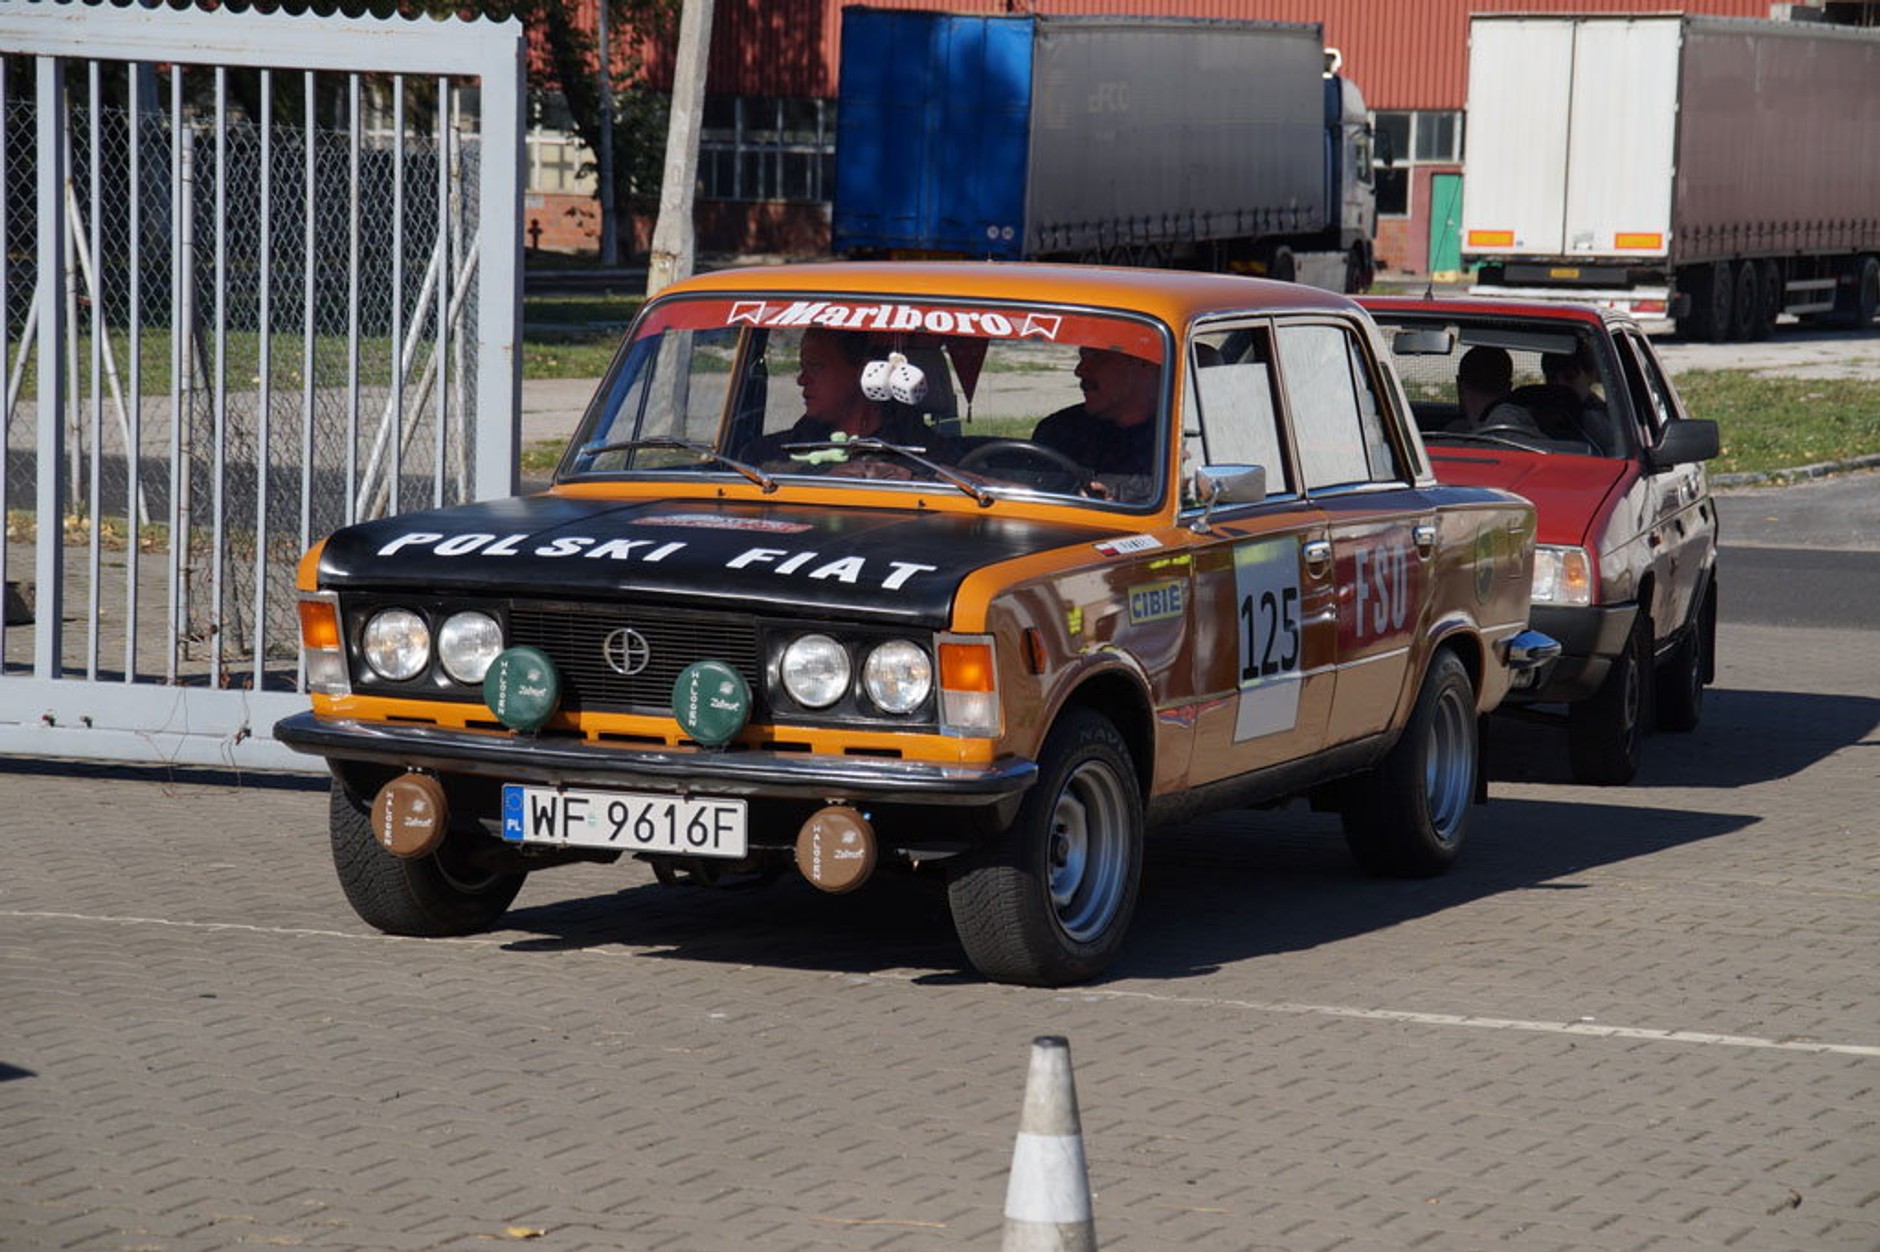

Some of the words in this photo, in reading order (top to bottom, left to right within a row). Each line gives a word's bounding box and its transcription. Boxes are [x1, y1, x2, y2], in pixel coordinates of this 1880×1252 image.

[765, 301, 1013, 336] Marlboro
[377, 532, 688, 562] POLSKI
[725, 547, 938, 591] FIAT
[1355, 543, 1408, 638] FSO
[1241, 587, 1300, 681] 125
[506, 818, 522, 832] PL
[531, 794, 589, 838] WF
[607, 801, 738, 848] 9616F
